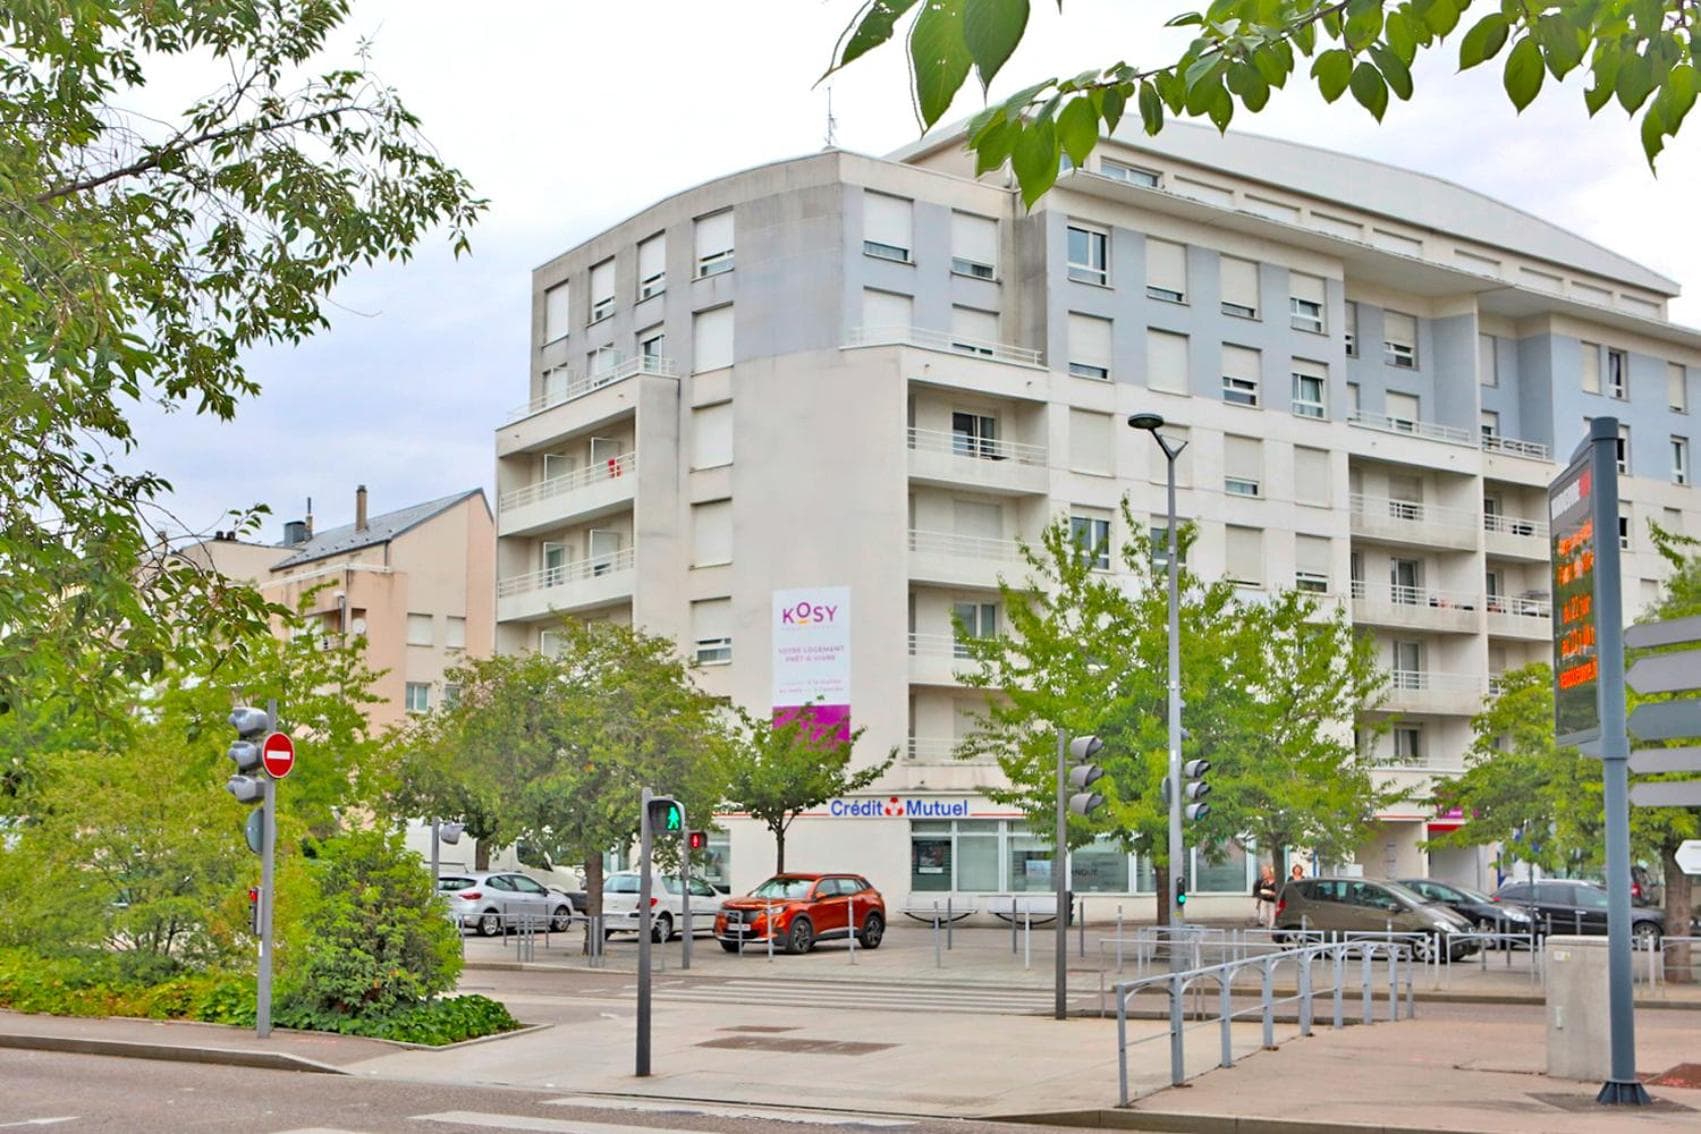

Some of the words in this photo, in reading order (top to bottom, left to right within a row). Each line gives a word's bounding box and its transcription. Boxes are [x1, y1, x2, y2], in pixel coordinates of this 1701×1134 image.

[782, 602, 838, 624] KOSY
[831, 800, 882, 816] Crédit
[906, 800, 968, 816] Mutuel
